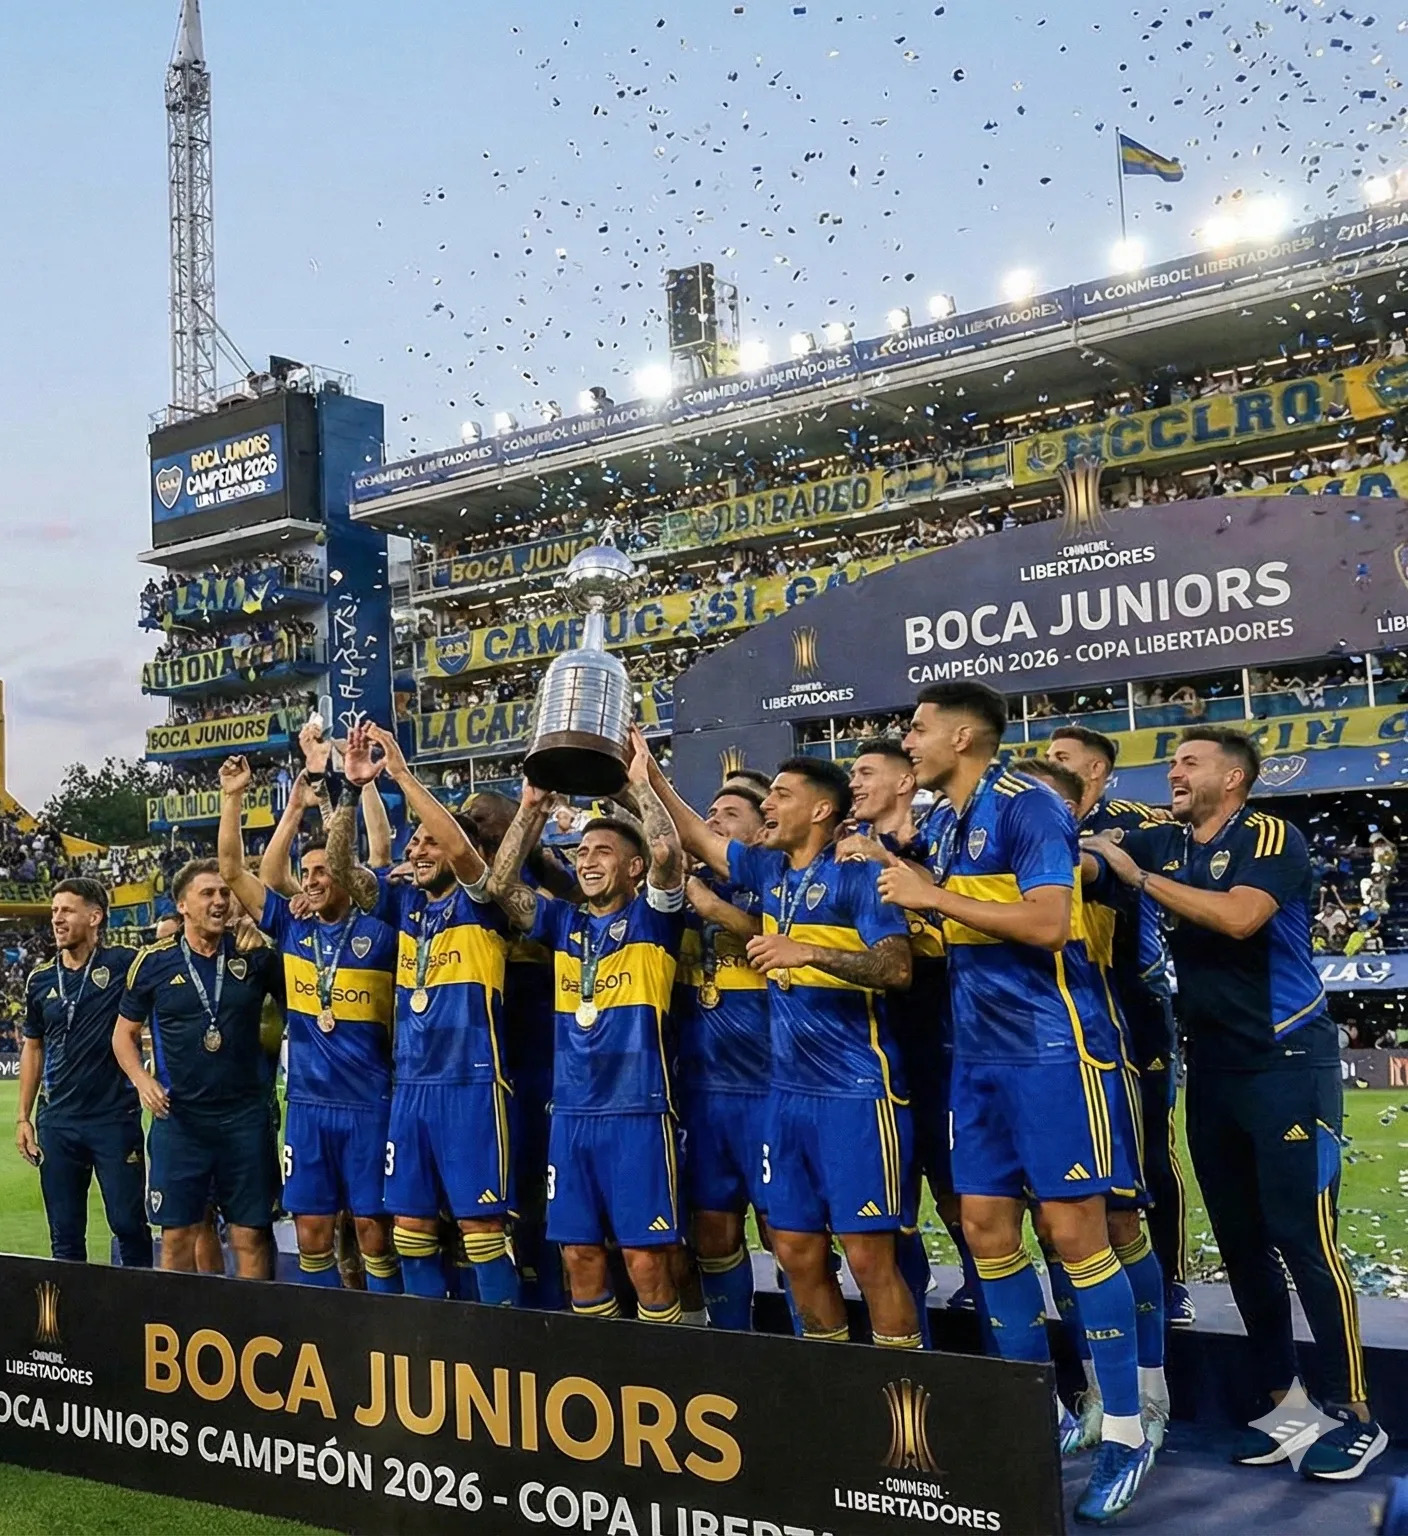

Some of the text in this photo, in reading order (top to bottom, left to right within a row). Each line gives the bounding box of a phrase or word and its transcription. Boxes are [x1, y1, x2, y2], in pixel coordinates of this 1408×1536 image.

[1083, 288, 1103, 305] LA
[244, 453, 277, 480] 2026
[450, 554, 515, 583] BOCA
[1020, 546, 1155, 582] LIBERTADORES
[905, 561, 1292, 655] BOCA JUNIORS
[1377, 615, 1408, 633] LIB
[908, 654, 1005, 684] CAMPEÓN
[1008, 648, 1059, 672] 2026
[1076, 642, 1130, 662] COPA
[1135, 617, 1294, 655] LIBERTADORES
[762, 687, 854, 710] LIBERTADORES
[195, 719, 266, 745] JUNIORS
[421, 712, 458, 749] LA
[294, 976, 370, 1004] beson
[6, 1359, 93, 1386] LIBERTADORES
[144, 1323, 743, 1483] BOCA JUNIORS
[56, 1402, 189, 1457] JUNIORS
[197, 1425, 373, 1492] CAMPEÓN
[383, 1457, 484, 1512] 2026
[518, 1481, 639, 1536] COPA
[834, 1488, 1001, 1532] LIBERTADORES
